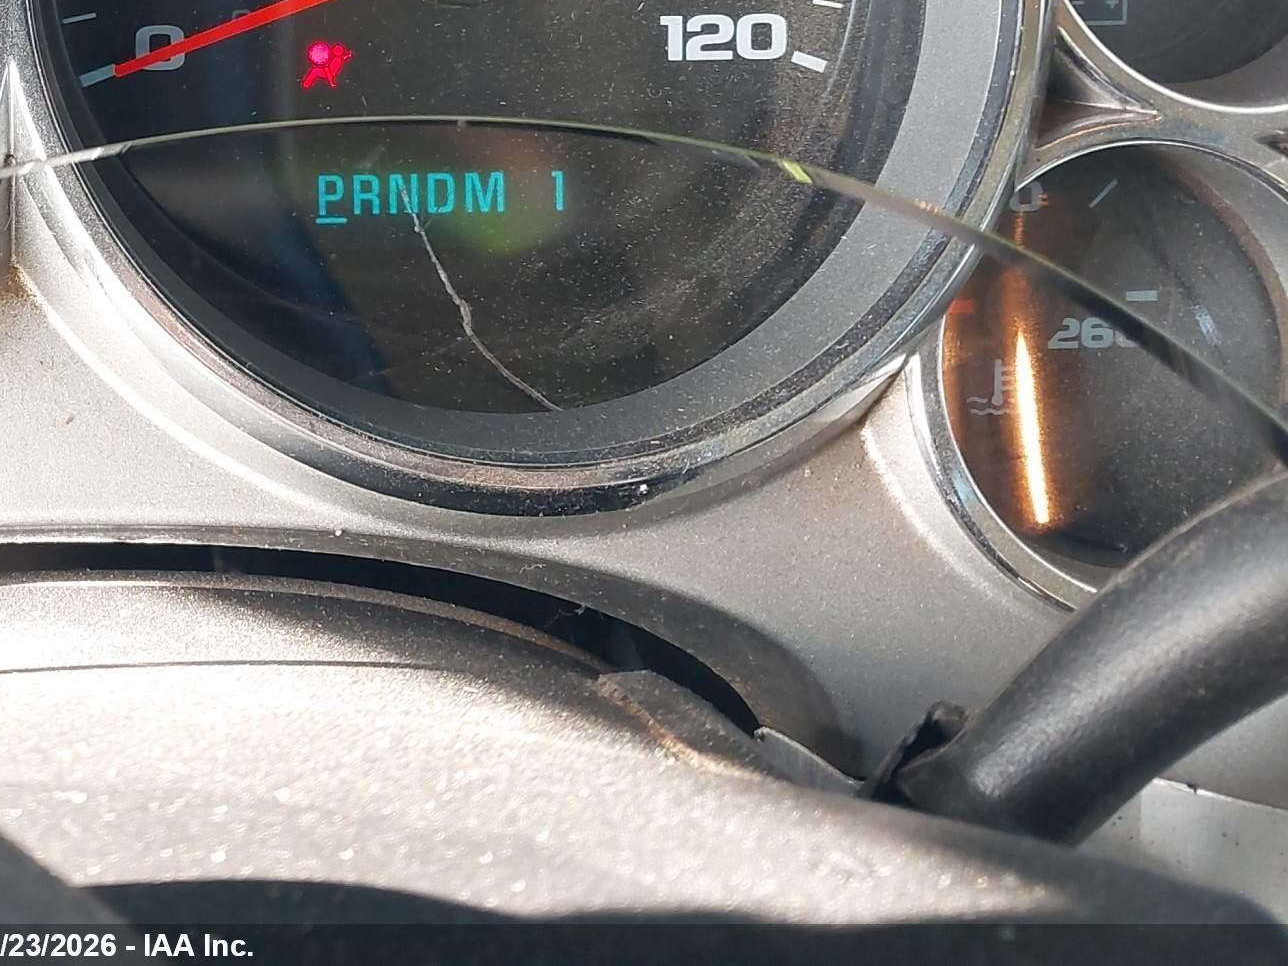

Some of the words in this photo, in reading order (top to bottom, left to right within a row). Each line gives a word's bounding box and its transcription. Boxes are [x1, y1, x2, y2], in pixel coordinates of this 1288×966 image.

[134, 25, 185, 72] 0
[660, 13, 788, 62] 120
[317, 170, 506, 217] PRNDM
[551, 170, 567, 211] 1
